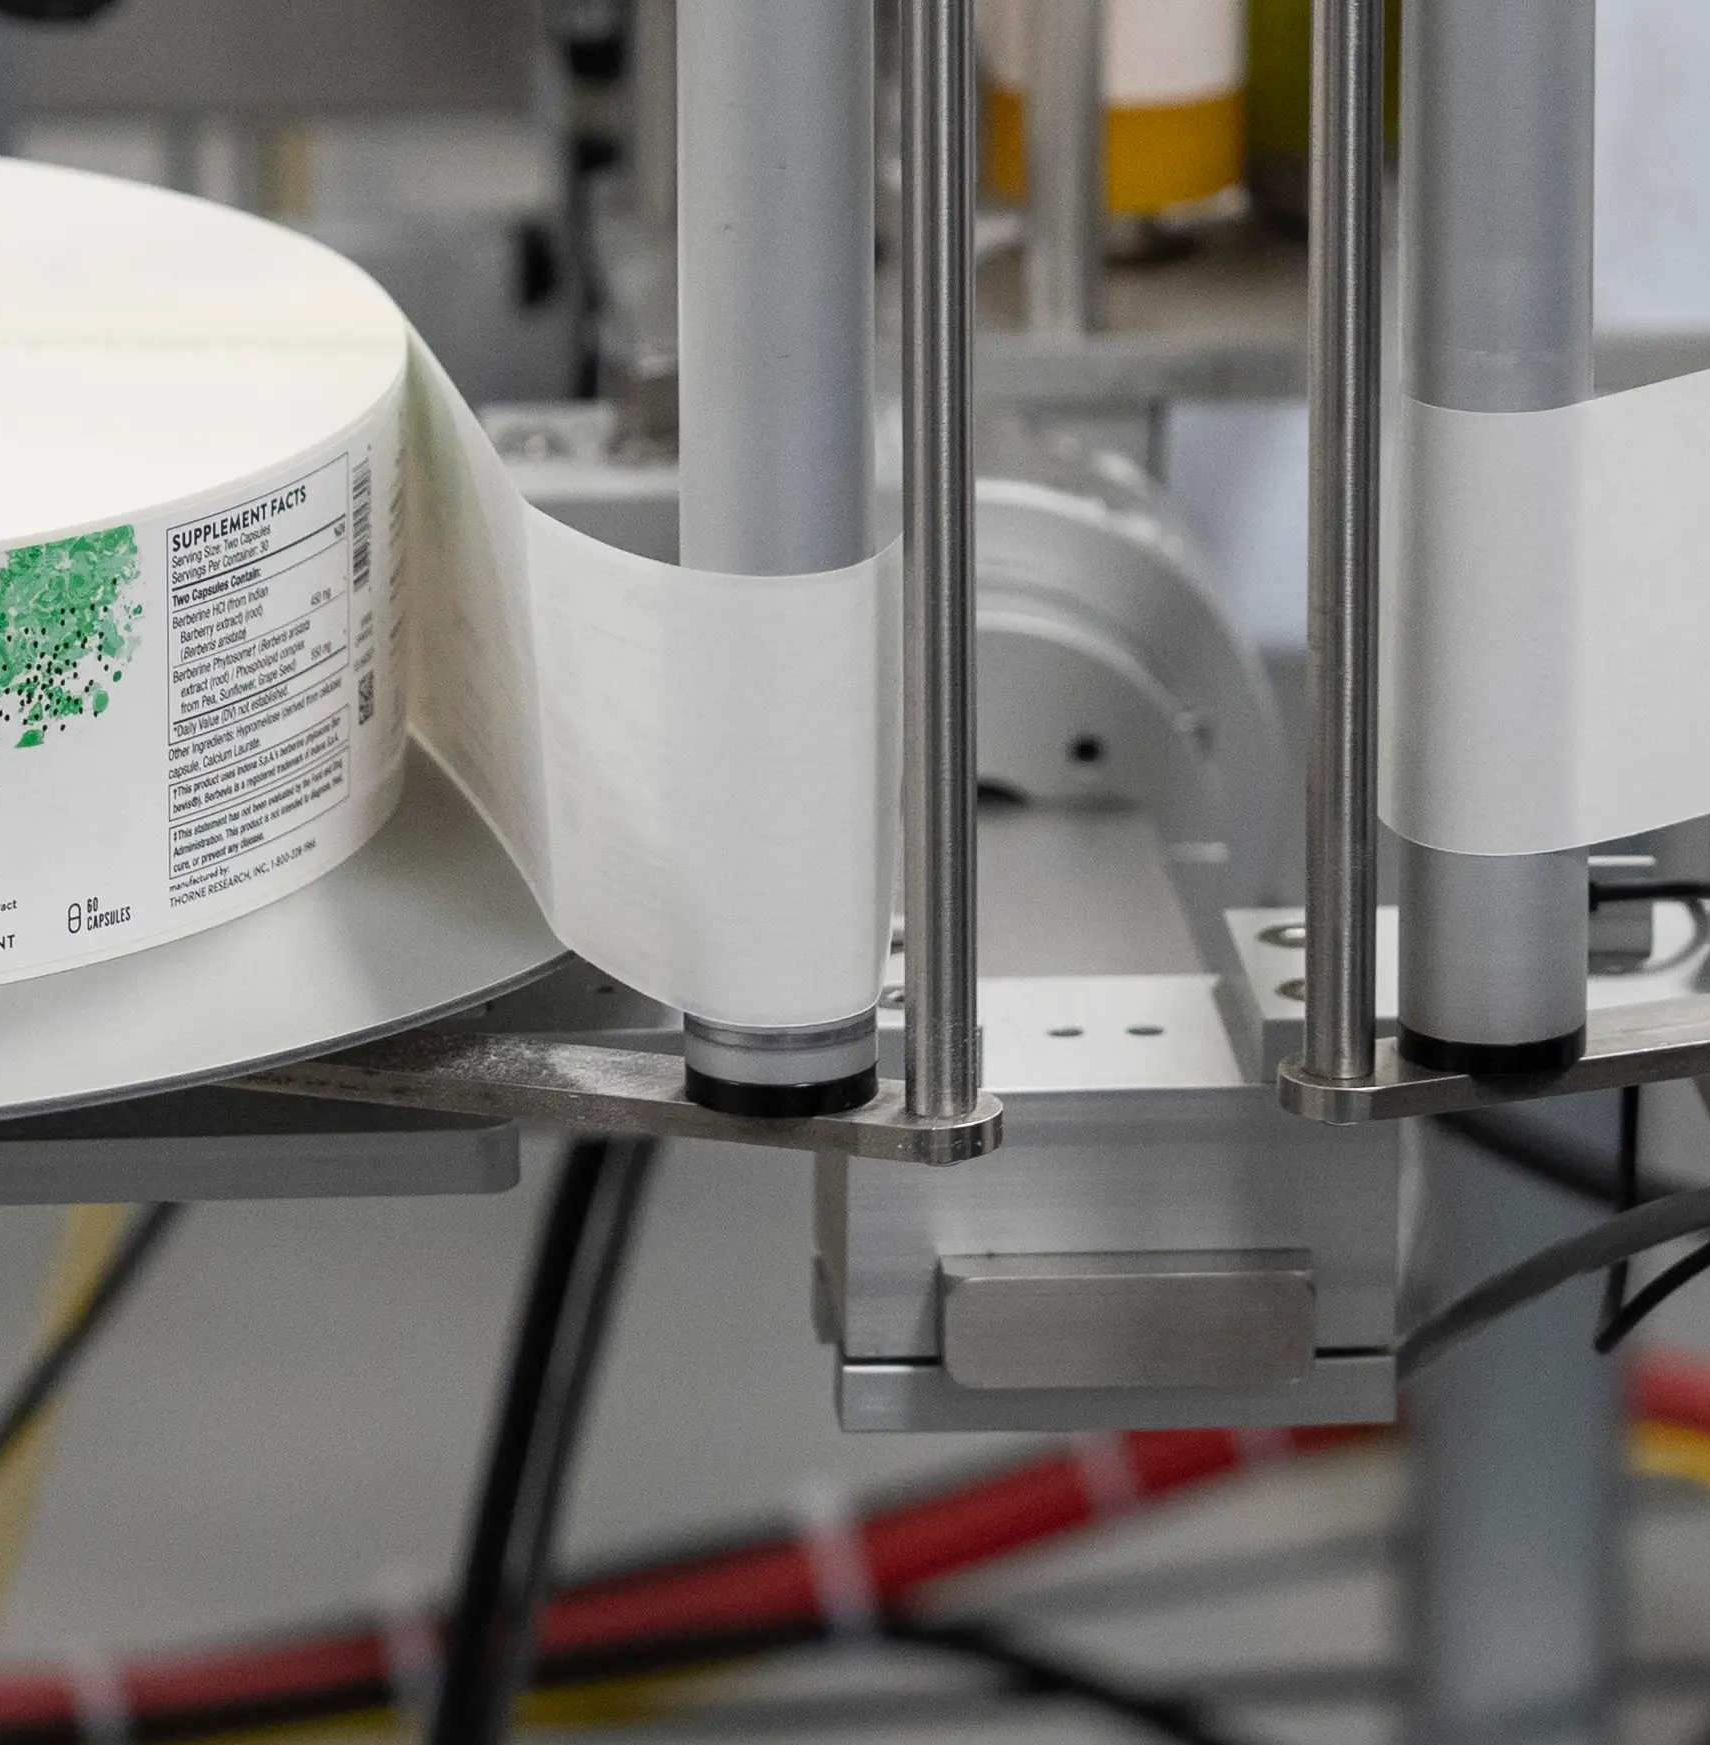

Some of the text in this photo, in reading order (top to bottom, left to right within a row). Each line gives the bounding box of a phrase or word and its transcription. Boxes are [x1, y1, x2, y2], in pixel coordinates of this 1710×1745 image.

[172, 485, 307, 552] SUPPLEMENT FACTS
[172, 567, 261, 608] Two Capsules Contain:
[86, 906, 131, 932] CAPSULES
[87, 896, 98, 913] 60
